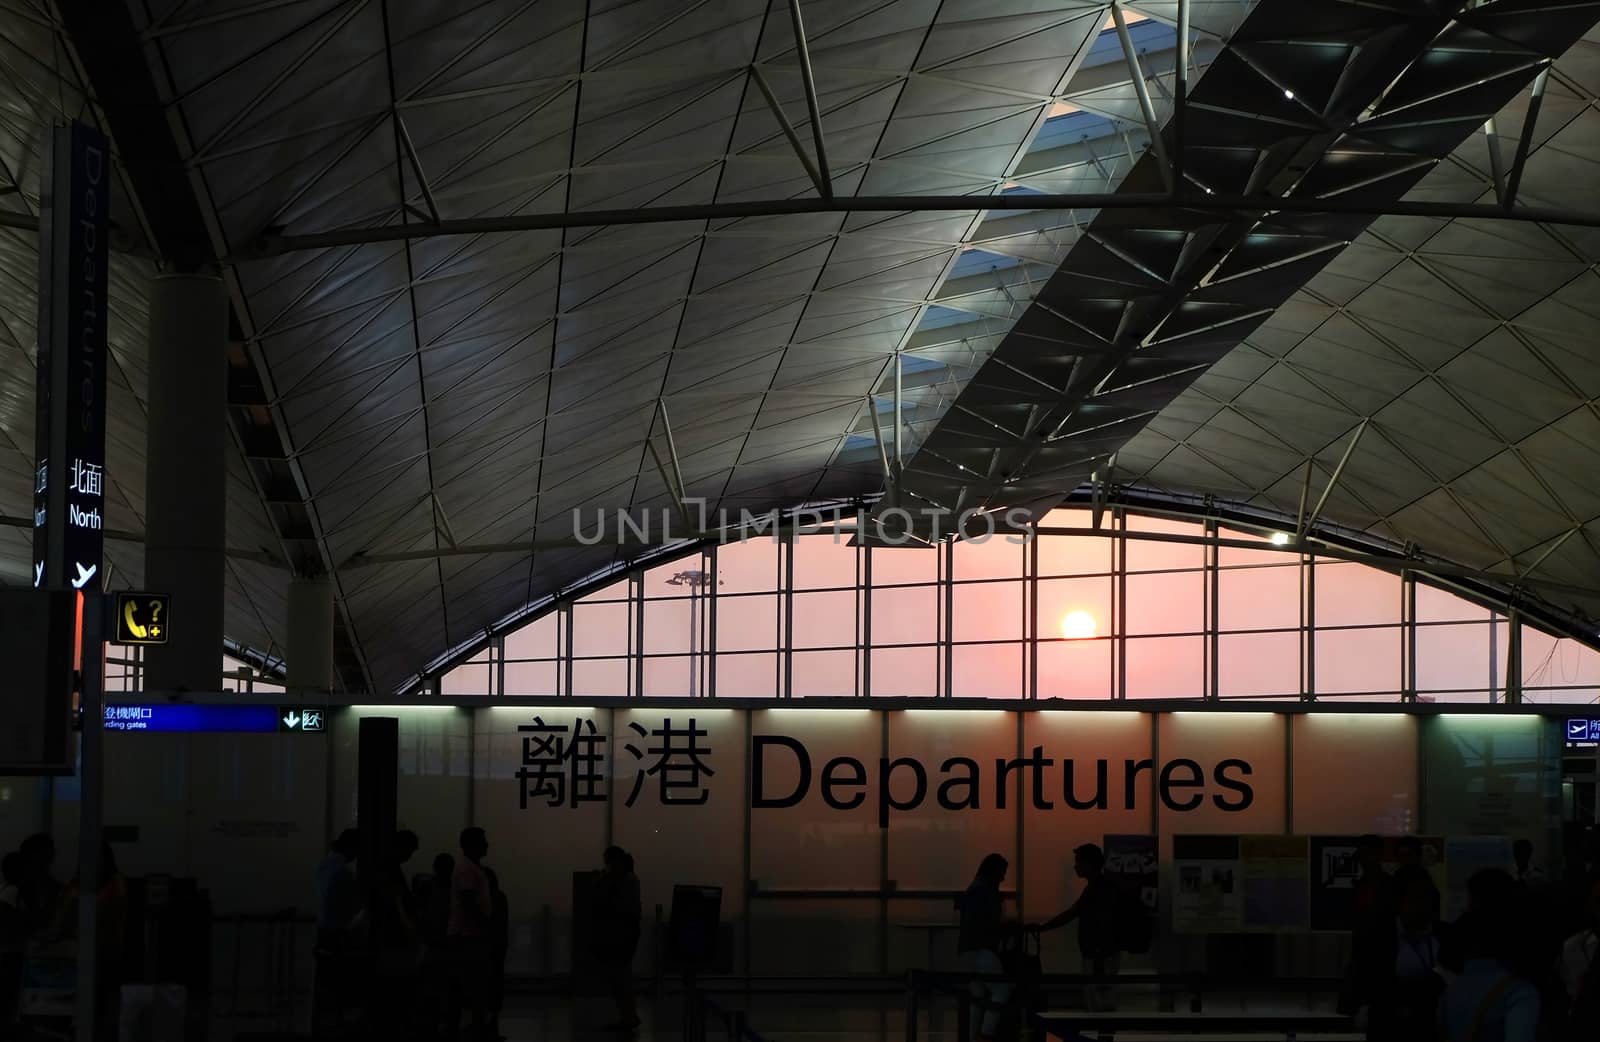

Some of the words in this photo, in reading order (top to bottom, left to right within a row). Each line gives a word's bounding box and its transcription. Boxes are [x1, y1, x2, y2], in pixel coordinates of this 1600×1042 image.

[82, 144, 103, 434] Departures
[69, 458, 102, 497] 北面
[69, 503, 101, 530] North
[126, 721, 147, 730] gates
[515, 717, 715, 810] 離港
[751, 736, 1255, 828] Departures
